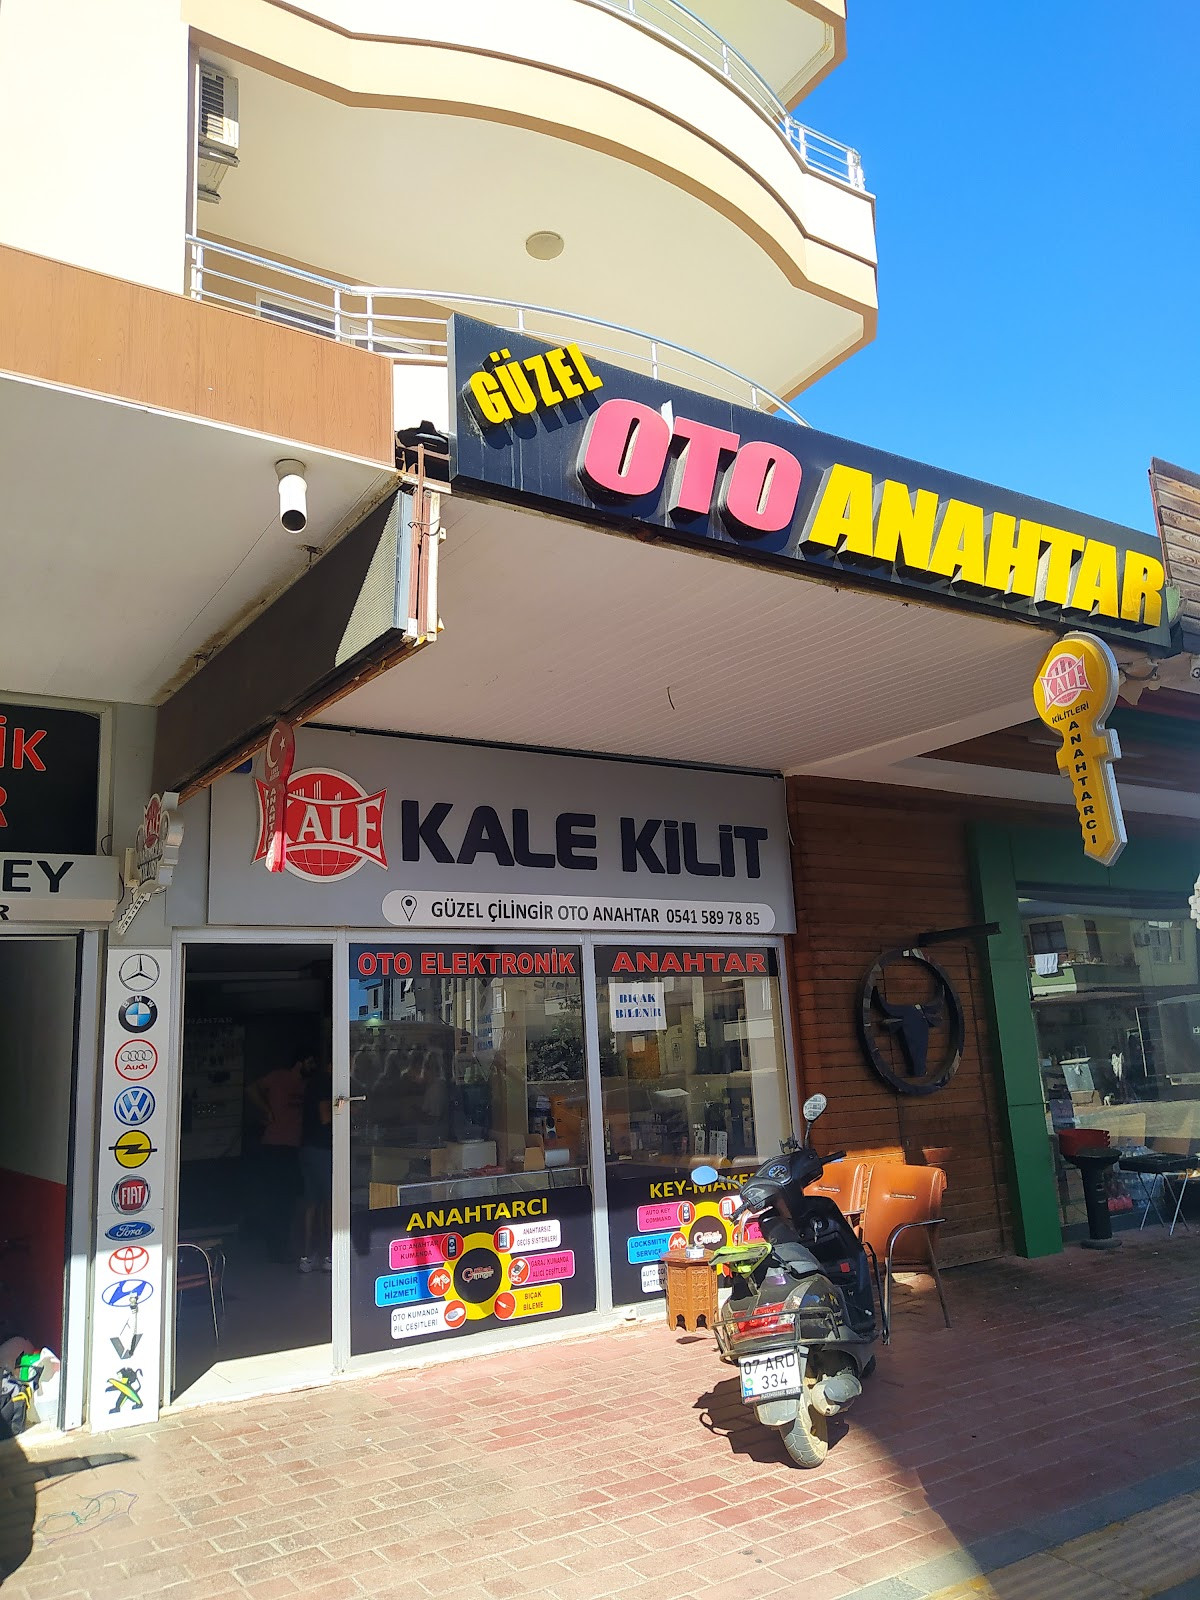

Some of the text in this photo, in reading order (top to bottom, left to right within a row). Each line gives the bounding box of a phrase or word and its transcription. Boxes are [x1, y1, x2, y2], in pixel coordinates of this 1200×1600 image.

[469, 342, 604, 424] GÜZEL
[583, 398, 1166, 627] OTO ANAHTAR
[1043, 661, 1088, 702] KALE
[1052, 700, 1090, 724] KİLİTLERİ
[1068, 720, 1098, 844] ANAHTARCI
[401, 799, 768, 879] KALE KİLİT
[2, 859, 75, 893] EY
[431, 898, 761, 926] GÜZEL ÇİLİNGİR OTO ANAHTAR 0541 589 78 85
[358, 948, 576, 975] OTO ELEKTRONİK
[611, 951, 767, 973] ANAHTAR
[122, 994, 155, 1009] BMW
[123, 1062, 148, 1071] Audi
[121, 1184, 144, 1206] FIAT
[406, 1197, 548, 1231] ANAHTARCI
[116, 1223, 144, 1238] Ford
[408, 1240, 439, 1250] ANAHTAR
[630, 1237, 667, 1249] LOCKSMITH
[400, 1250, 432, 1260] KUMANDA
[383, 1276, 418, 1289] ÇİLİNGİR
[643, 1268, 656, 1277] AUTO
[384, 1287, 417, 1300] HİZMETİ
[393, 1308, 439, 1322] OTO KUMANDA
[744, 1352, 796, 1375] 07 ARD
[761, 1372, 788, 1389] 334
